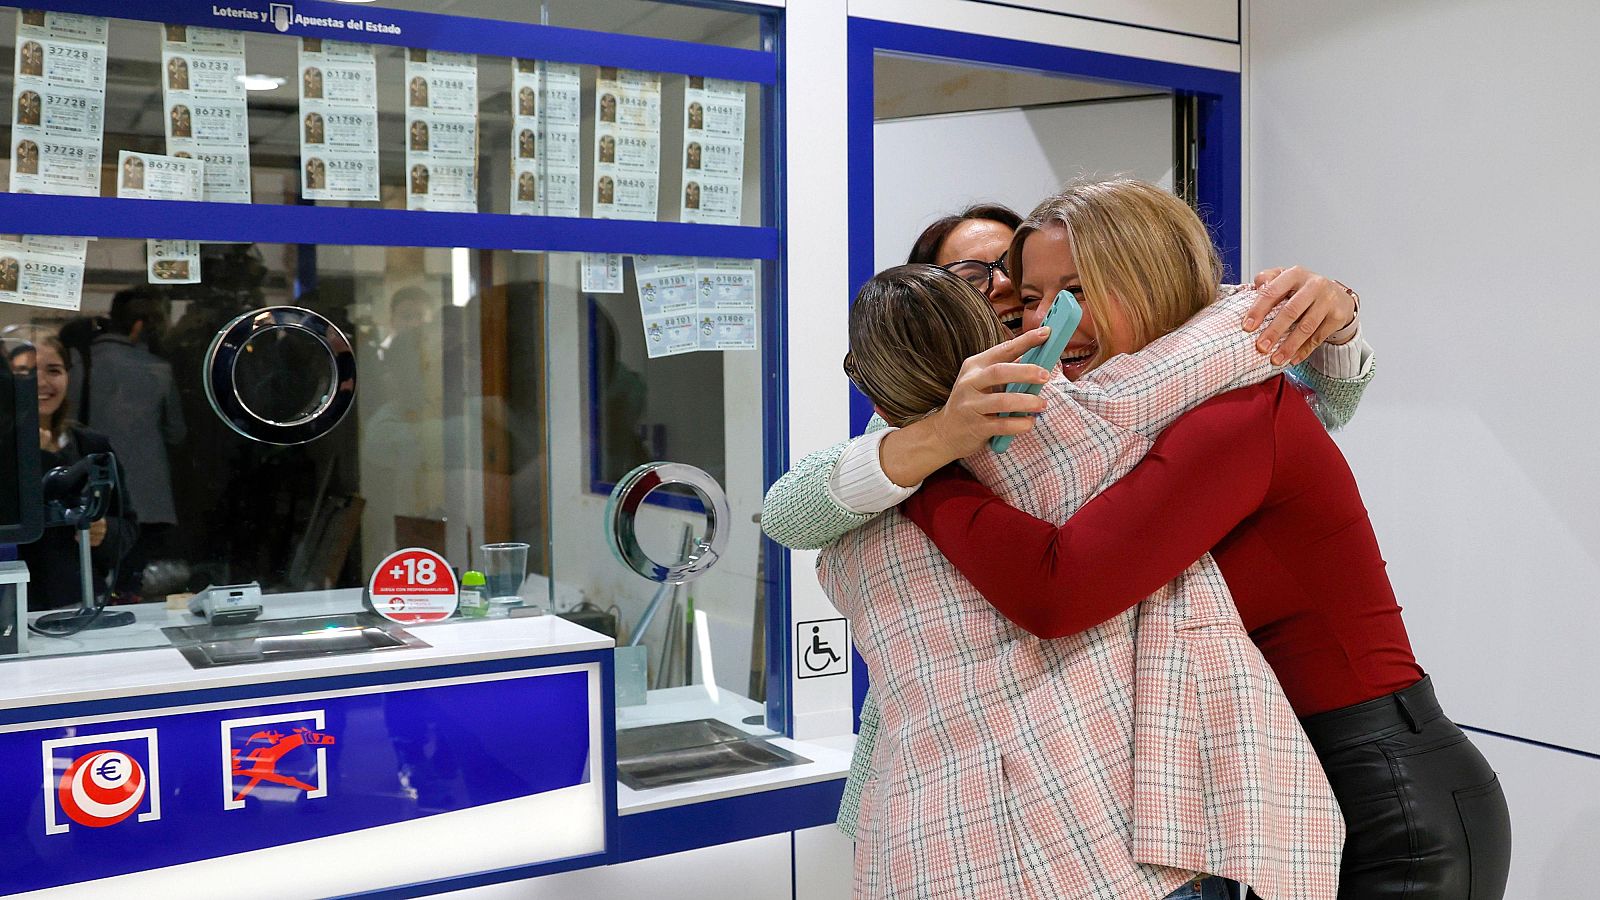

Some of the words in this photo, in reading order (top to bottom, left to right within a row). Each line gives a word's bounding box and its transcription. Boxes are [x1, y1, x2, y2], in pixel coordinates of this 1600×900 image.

[213, 5, 258, 19] Loterías
[260, 12, 268, 22] y
[295, 13, 344, 28] Apuestas
[347, 19, 363, 30] del
[365, 21, 401, 35] Estado
[49, 46, 88, 58] 37728
[192, 61, 229, 71] 86732
[47, 95, 86, 107] 37728
[195, 108, 231, 118] 86732
[44, 144, 83, 156] 37728
[197, 155, 233, 165] 86732
[148, 161, 186, 172] 86732
[24, 262, 65, 275] 61204
[389, 558, 437, 585] +18
